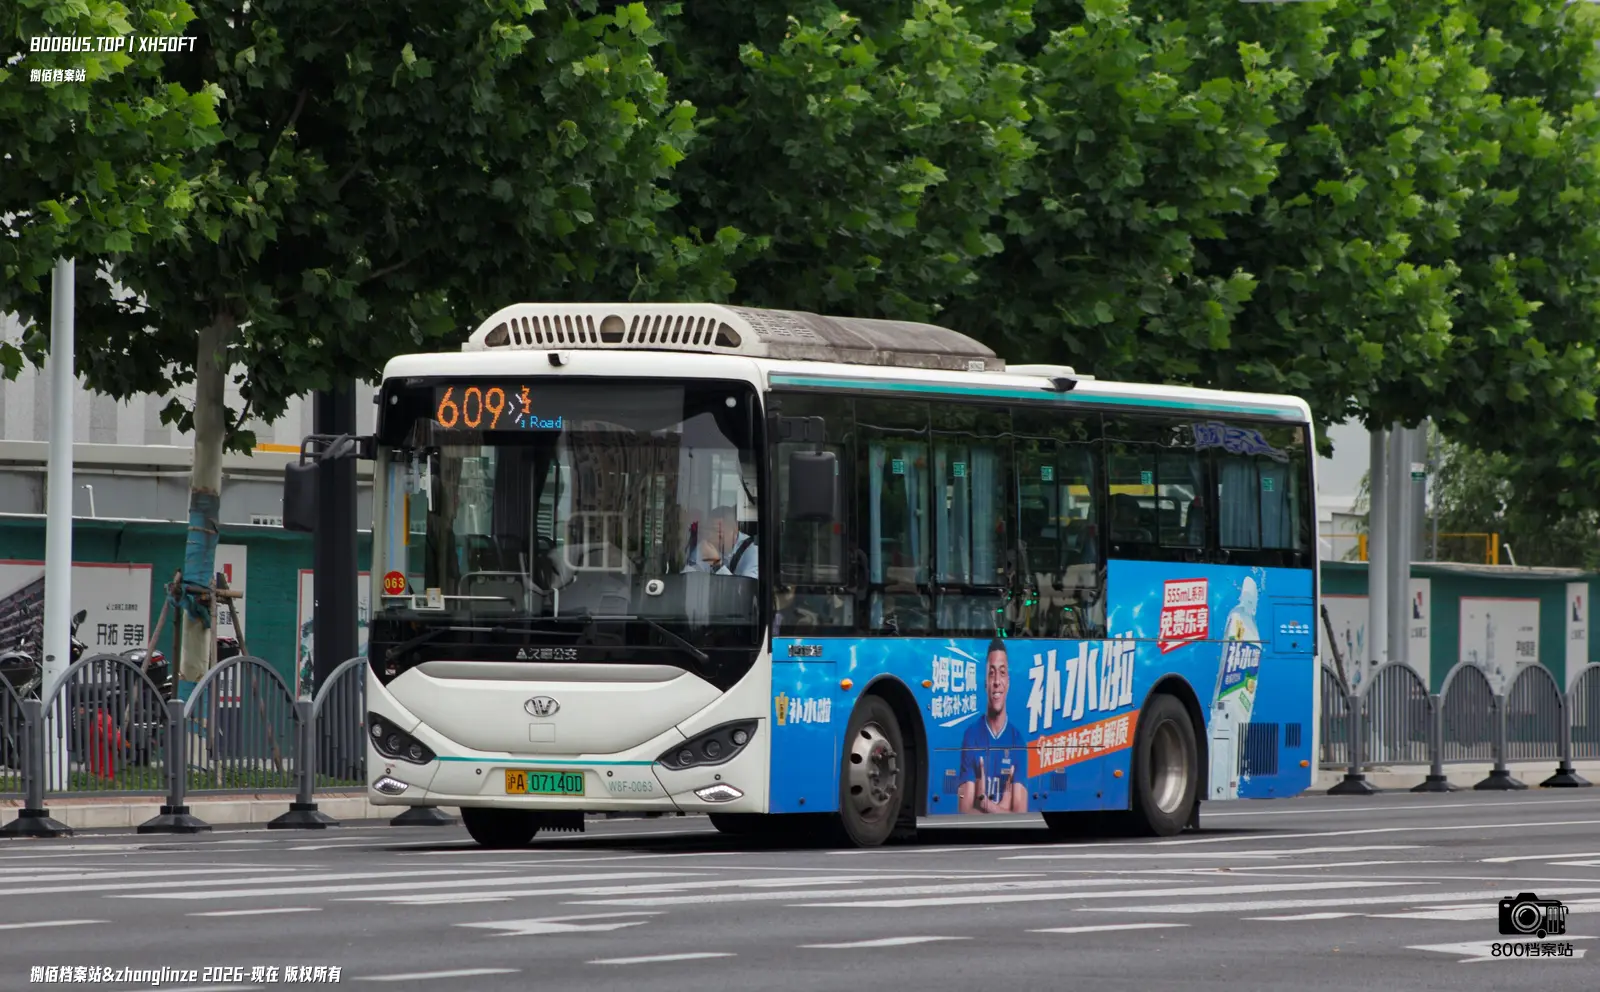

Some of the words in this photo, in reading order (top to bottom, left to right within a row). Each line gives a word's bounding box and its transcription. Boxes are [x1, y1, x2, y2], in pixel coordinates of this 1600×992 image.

[437, 386, 505, 429] 609
[530, 416, 562, 428] Road
[385, 578, 405, 589] 063
[1167, 586, 1205, 603] 555mL系列
[97, 623, 118, 645] 开拓
[123, 623, 144, 646] 竞争
[1159, 608, 1208, 640] 免费乐享
[932, 654, 977, 693] 姆巴佩
[1027, 630, 1135, 733] 补水啦
[789, 697, 832, 724] 补水啦
[1039, 716, 1130, 769] 快速补充电解质
[608, 780, 653, 793] W8F-0063
